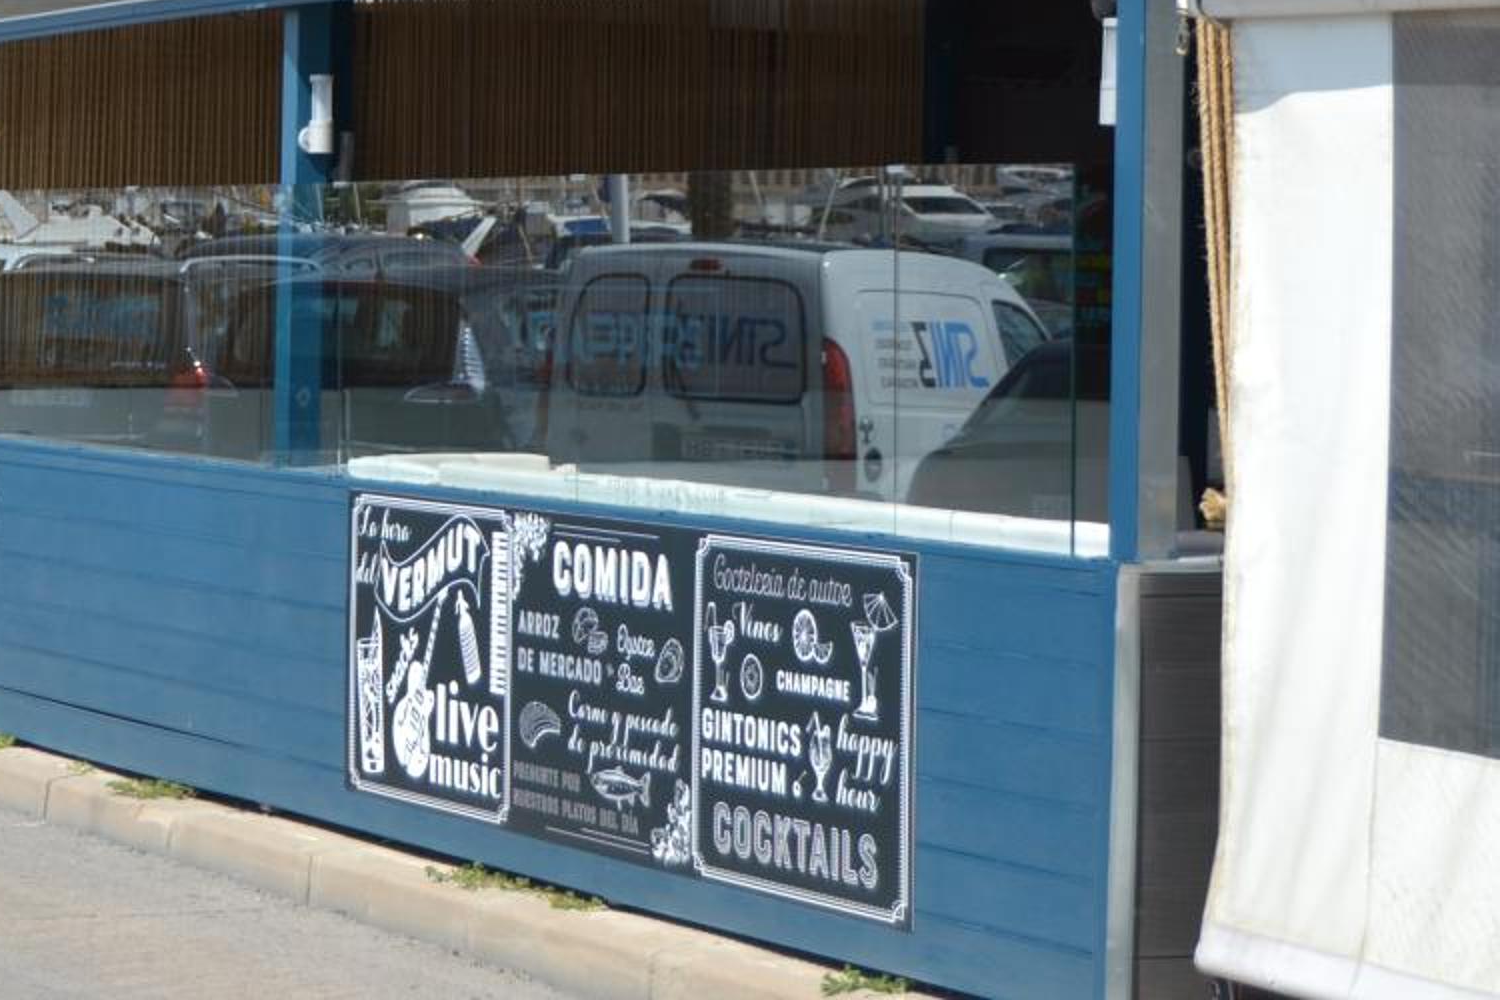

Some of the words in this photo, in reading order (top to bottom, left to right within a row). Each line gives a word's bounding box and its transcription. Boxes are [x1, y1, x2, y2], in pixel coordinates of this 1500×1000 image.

[357, 505, 377, 538] La
[381, 507, 411, 542] hora
[356, 552, 378, 584] del
[381, 522, 482, 612] VERMUT
[553, 540, 674, 612] COMIDA
[787, 568, 807, 601] de
[517, 609, 561, 640] ARROZ
[732, 601, 783, 643] Vinos
[517, 647, 534, 673] DE
[539, 651, 603, 686] MERCADO
[775, 669, 851, 703] CHAMPAGNE
[436, 679, 499, 753] live
[568, 689, 607, 724] Carne
[611, 711, 622, 746] y
[623, 707, 679, 750] pescado
[701, 707, 801, 757] GINTONICS
[567, 723, 584, 754] de
[586, 739, 680, 775] proximidad
[701, 747, 787, 796] PREMIUM
[835, 713, 898, 786] happy
[429, 753, 502, 799] music
[835, 769, 880, 813] hour
[713, 801, 879, 889] COCKTAILS
